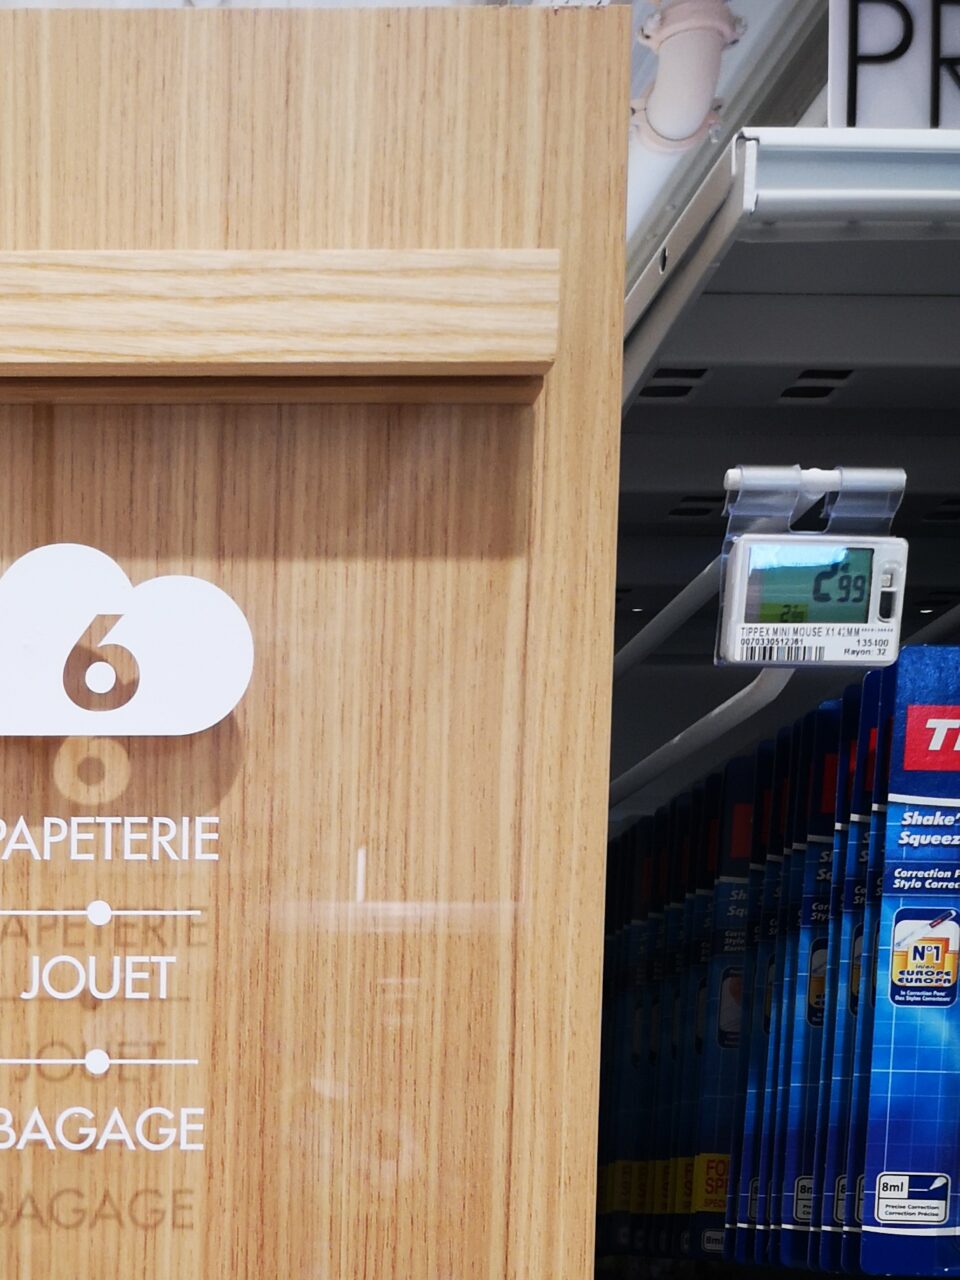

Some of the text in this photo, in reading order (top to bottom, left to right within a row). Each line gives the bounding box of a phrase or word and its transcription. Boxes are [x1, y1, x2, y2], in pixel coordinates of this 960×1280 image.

[772, 627, 790, 636] MINI
[792, 628, 823, 637] MOUSE
[62, 614, 140, 711] 6
[894, 868, 951, 878] Correction
[893, 879, 922, 889] Stylo
[20, 955, 177, 1000] JOUET
[882, 1181, 904, 1192] 8ml
